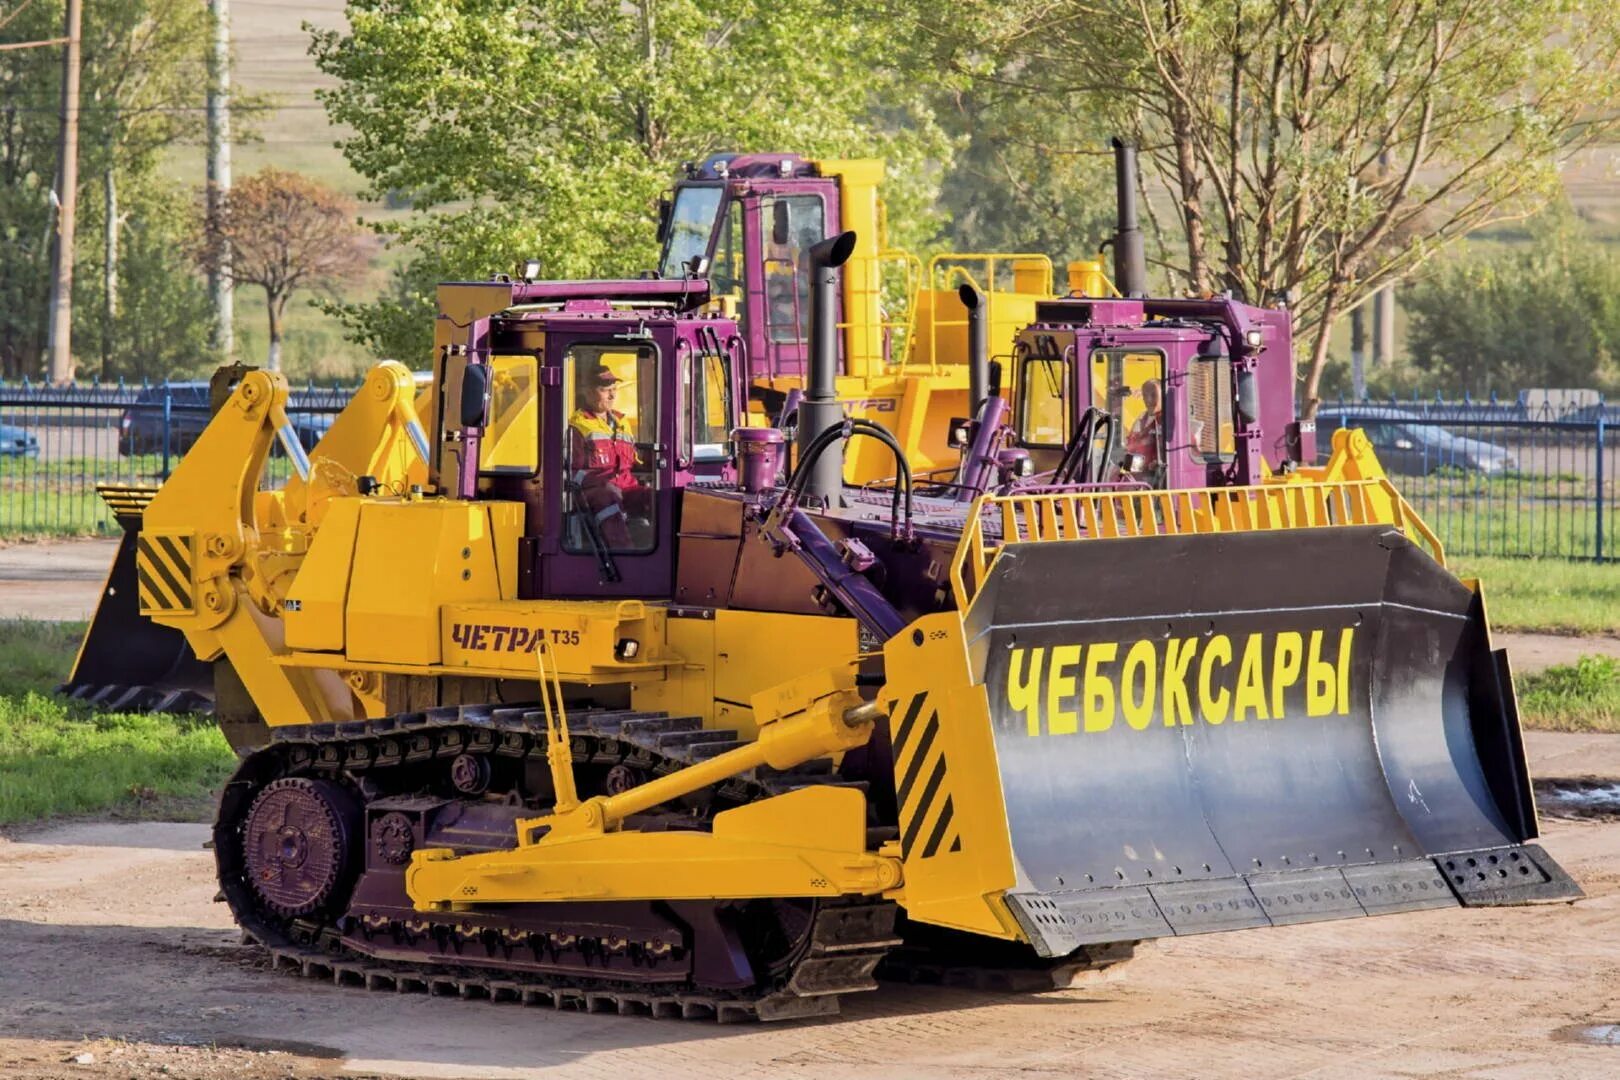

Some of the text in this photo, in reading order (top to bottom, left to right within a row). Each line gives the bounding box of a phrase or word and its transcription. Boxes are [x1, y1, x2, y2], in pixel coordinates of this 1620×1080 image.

[452, 623, 580, 654] ЧЕТРА Т35
[1007, 627, 1354, 737] ЧЕБОКСАРЫ
